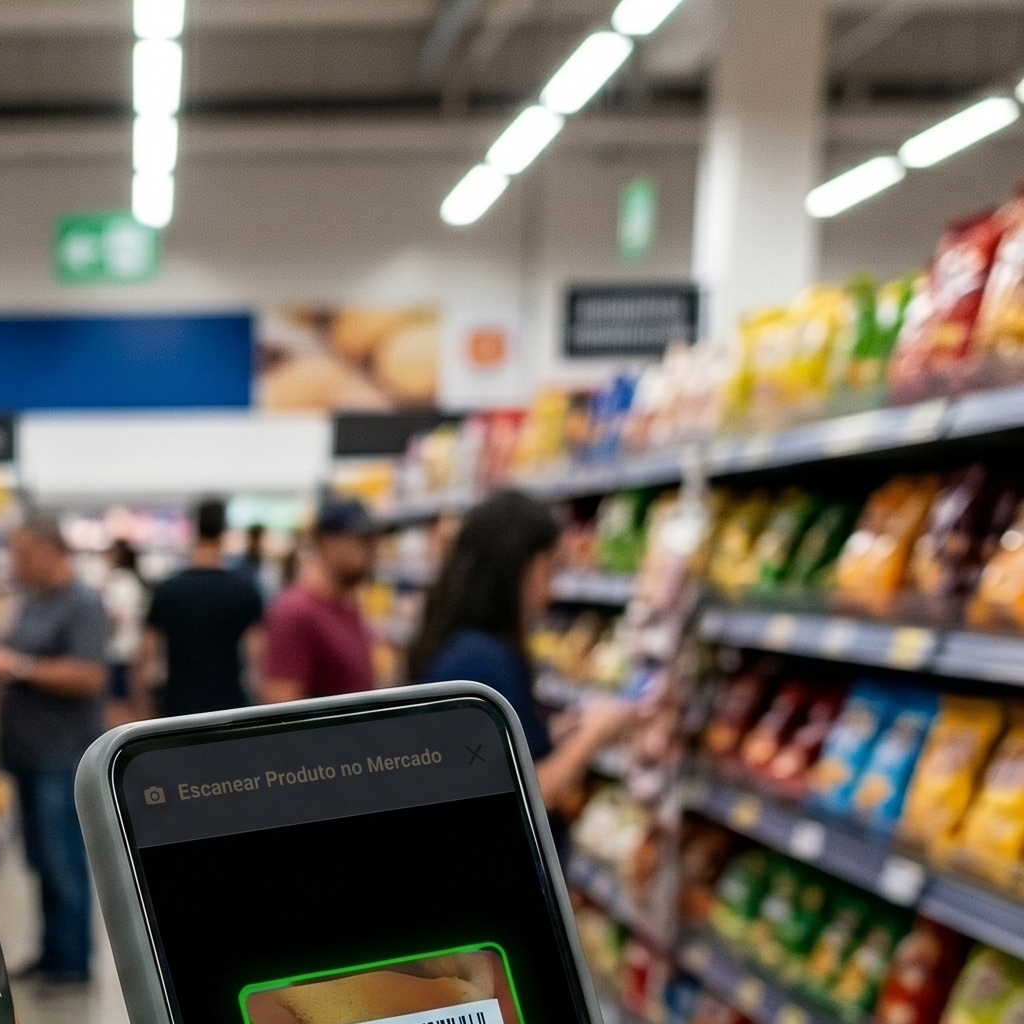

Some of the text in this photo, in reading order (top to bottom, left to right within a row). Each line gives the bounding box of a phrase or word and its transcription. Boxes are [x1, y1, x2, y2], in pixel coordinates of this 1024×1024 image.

[178, 748, 443, 800] Escanear Produto no Mercado
